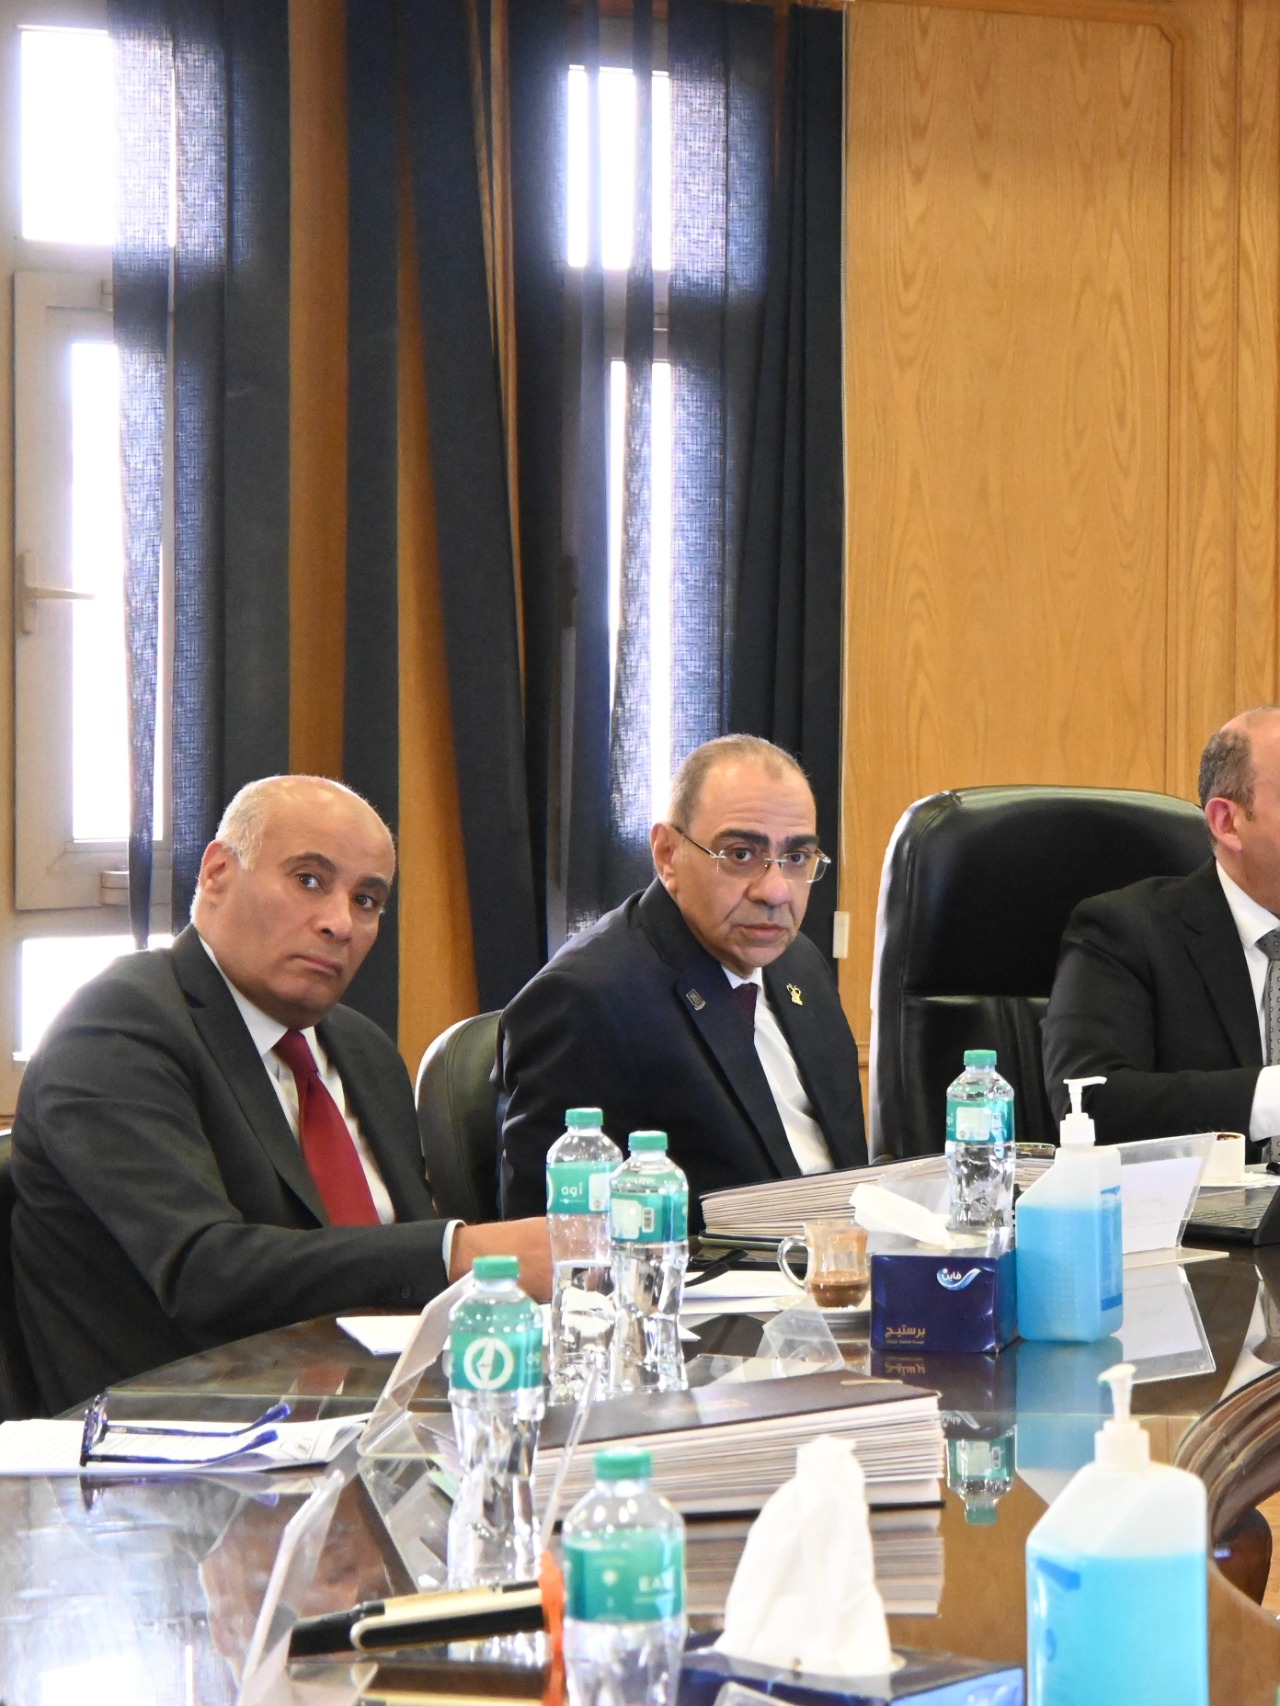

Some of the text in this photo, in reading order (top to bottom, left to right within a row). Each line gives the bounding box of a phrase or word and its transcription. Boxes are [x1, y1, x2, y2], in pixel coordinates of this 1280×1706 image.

[561, 1182, 583, 1198] ogi
[942, 1268, 962, 1282] فاين
[885, 1325, 926, 1338] برستيج
